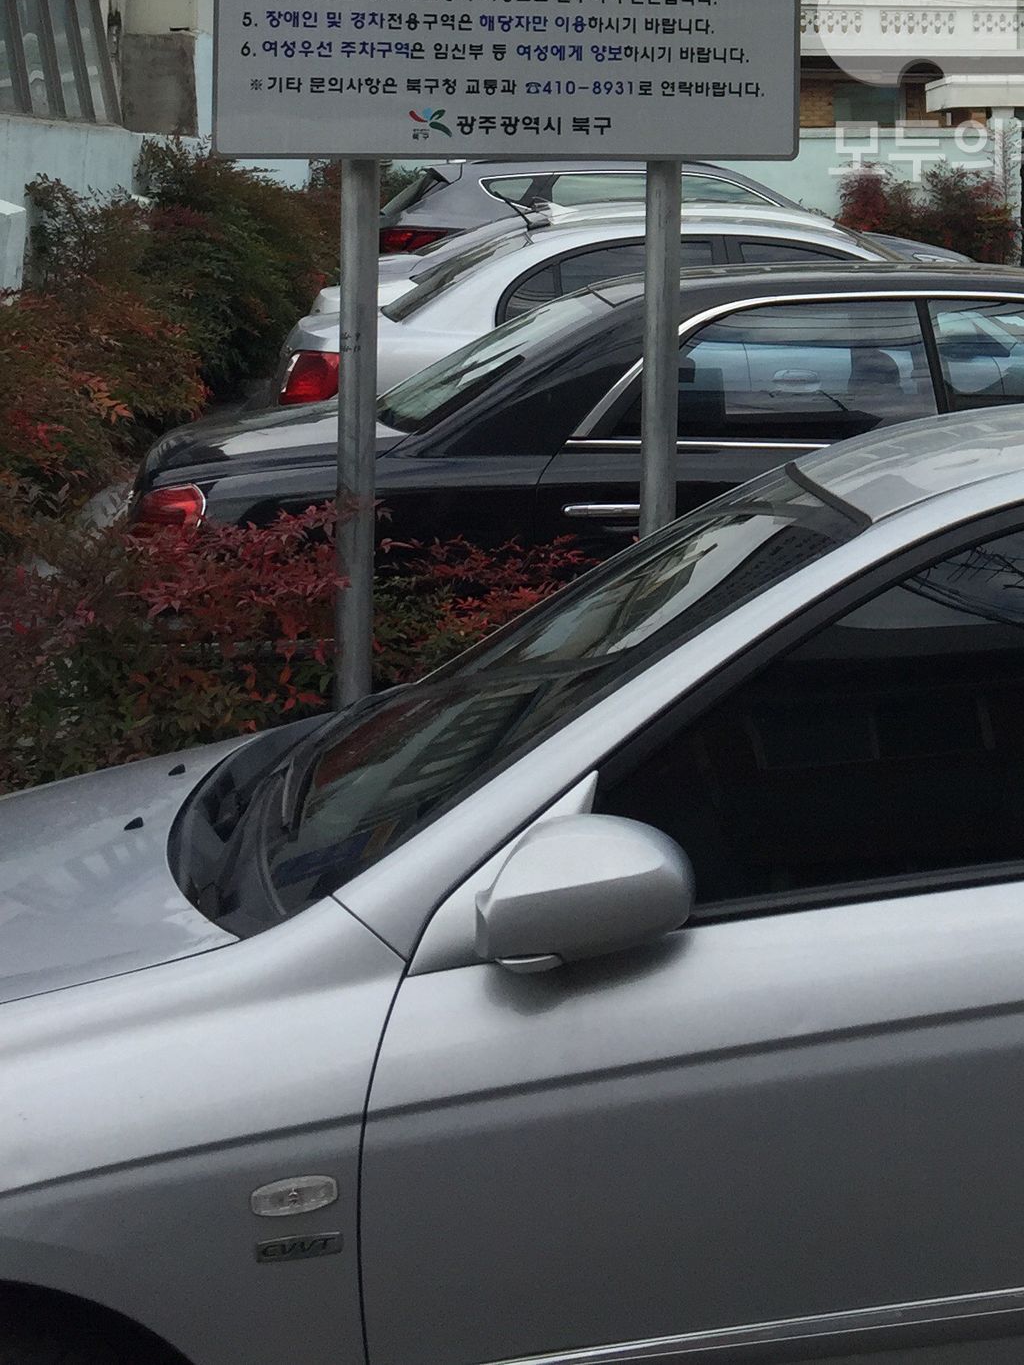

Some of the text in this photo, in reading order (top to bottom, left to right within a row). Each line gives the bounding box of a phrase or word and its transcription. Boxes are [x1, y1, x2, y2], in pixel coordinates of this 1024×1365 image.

[241, 10, 715, 35] 5. 장애인 및 경차전용구역은 해당자만 이용하시기 바랍니다.
[240, 40, 750, 65] 6. 여성우선 주차구역은 임신부 등 여성에게 양보하시기 바랍니다.
[309, 76, 398, 96] 문의사항은
[406, 77, 457, 96] 북구청
[464, 78, 518, 96] 교통과
[660, 80, 765, 98] 연락바랍니다.
[456, 115, 612, 136] 광주광역시 북구
